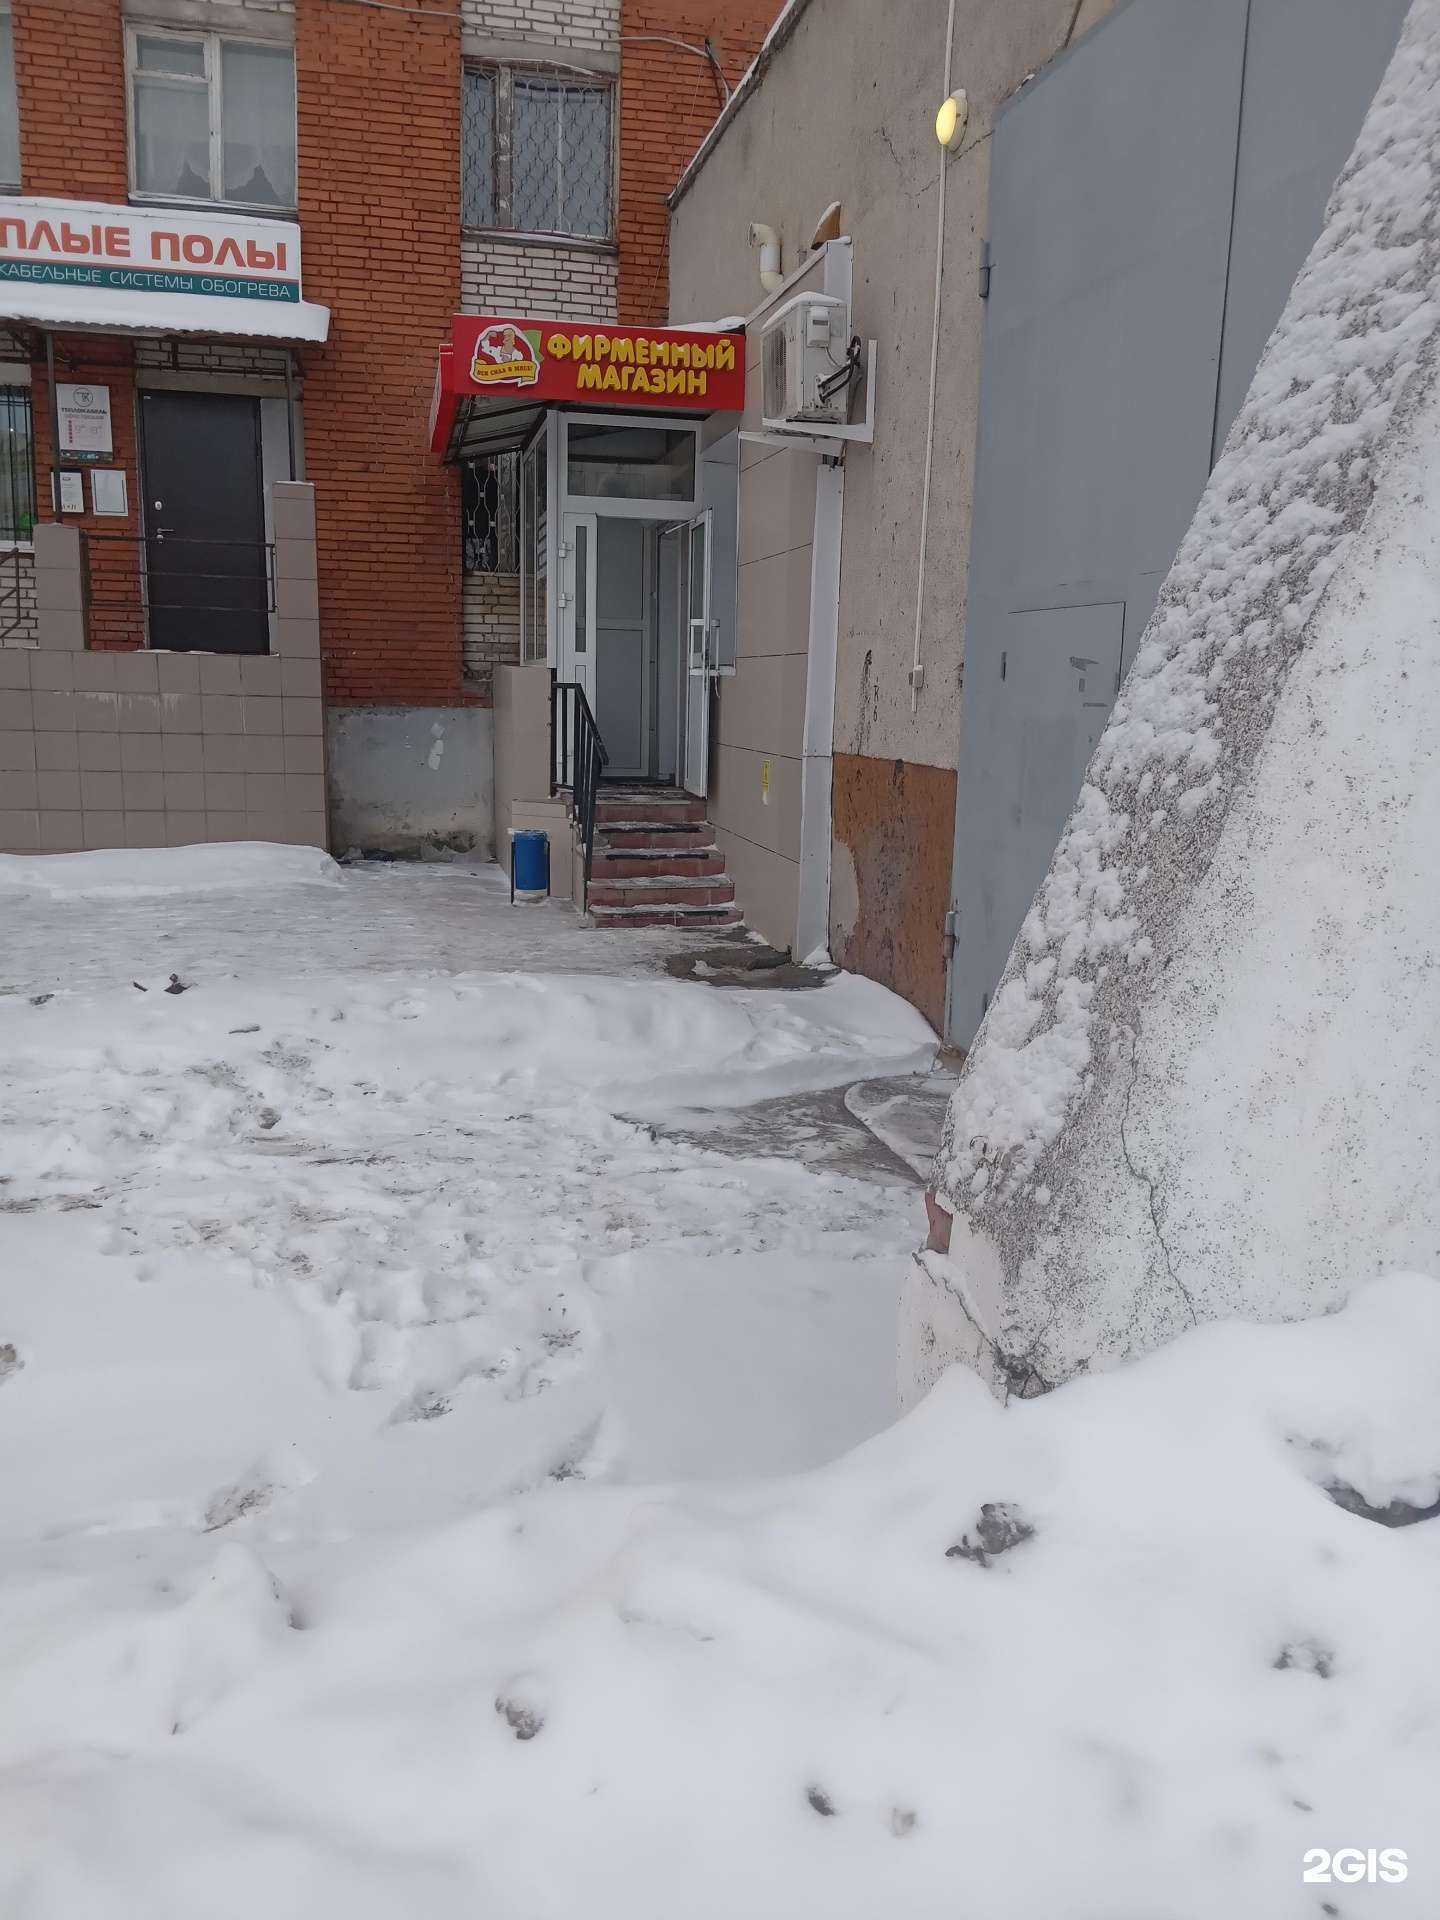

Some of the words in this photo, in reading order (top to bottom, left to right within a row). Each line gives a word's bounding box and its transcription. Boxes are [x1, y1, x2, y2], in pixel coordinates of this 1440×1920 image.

[150, 231, 287, 271] ПОЛЫ
[109, 270, 193, 290] СИСТЕМЫ
[201, 278, 291, 298] ОБОГРЕВА
[546, 332, 736, 371] ФИРМЕННЫЙ
[576, 363, 708, 396] МАГАЗИН
